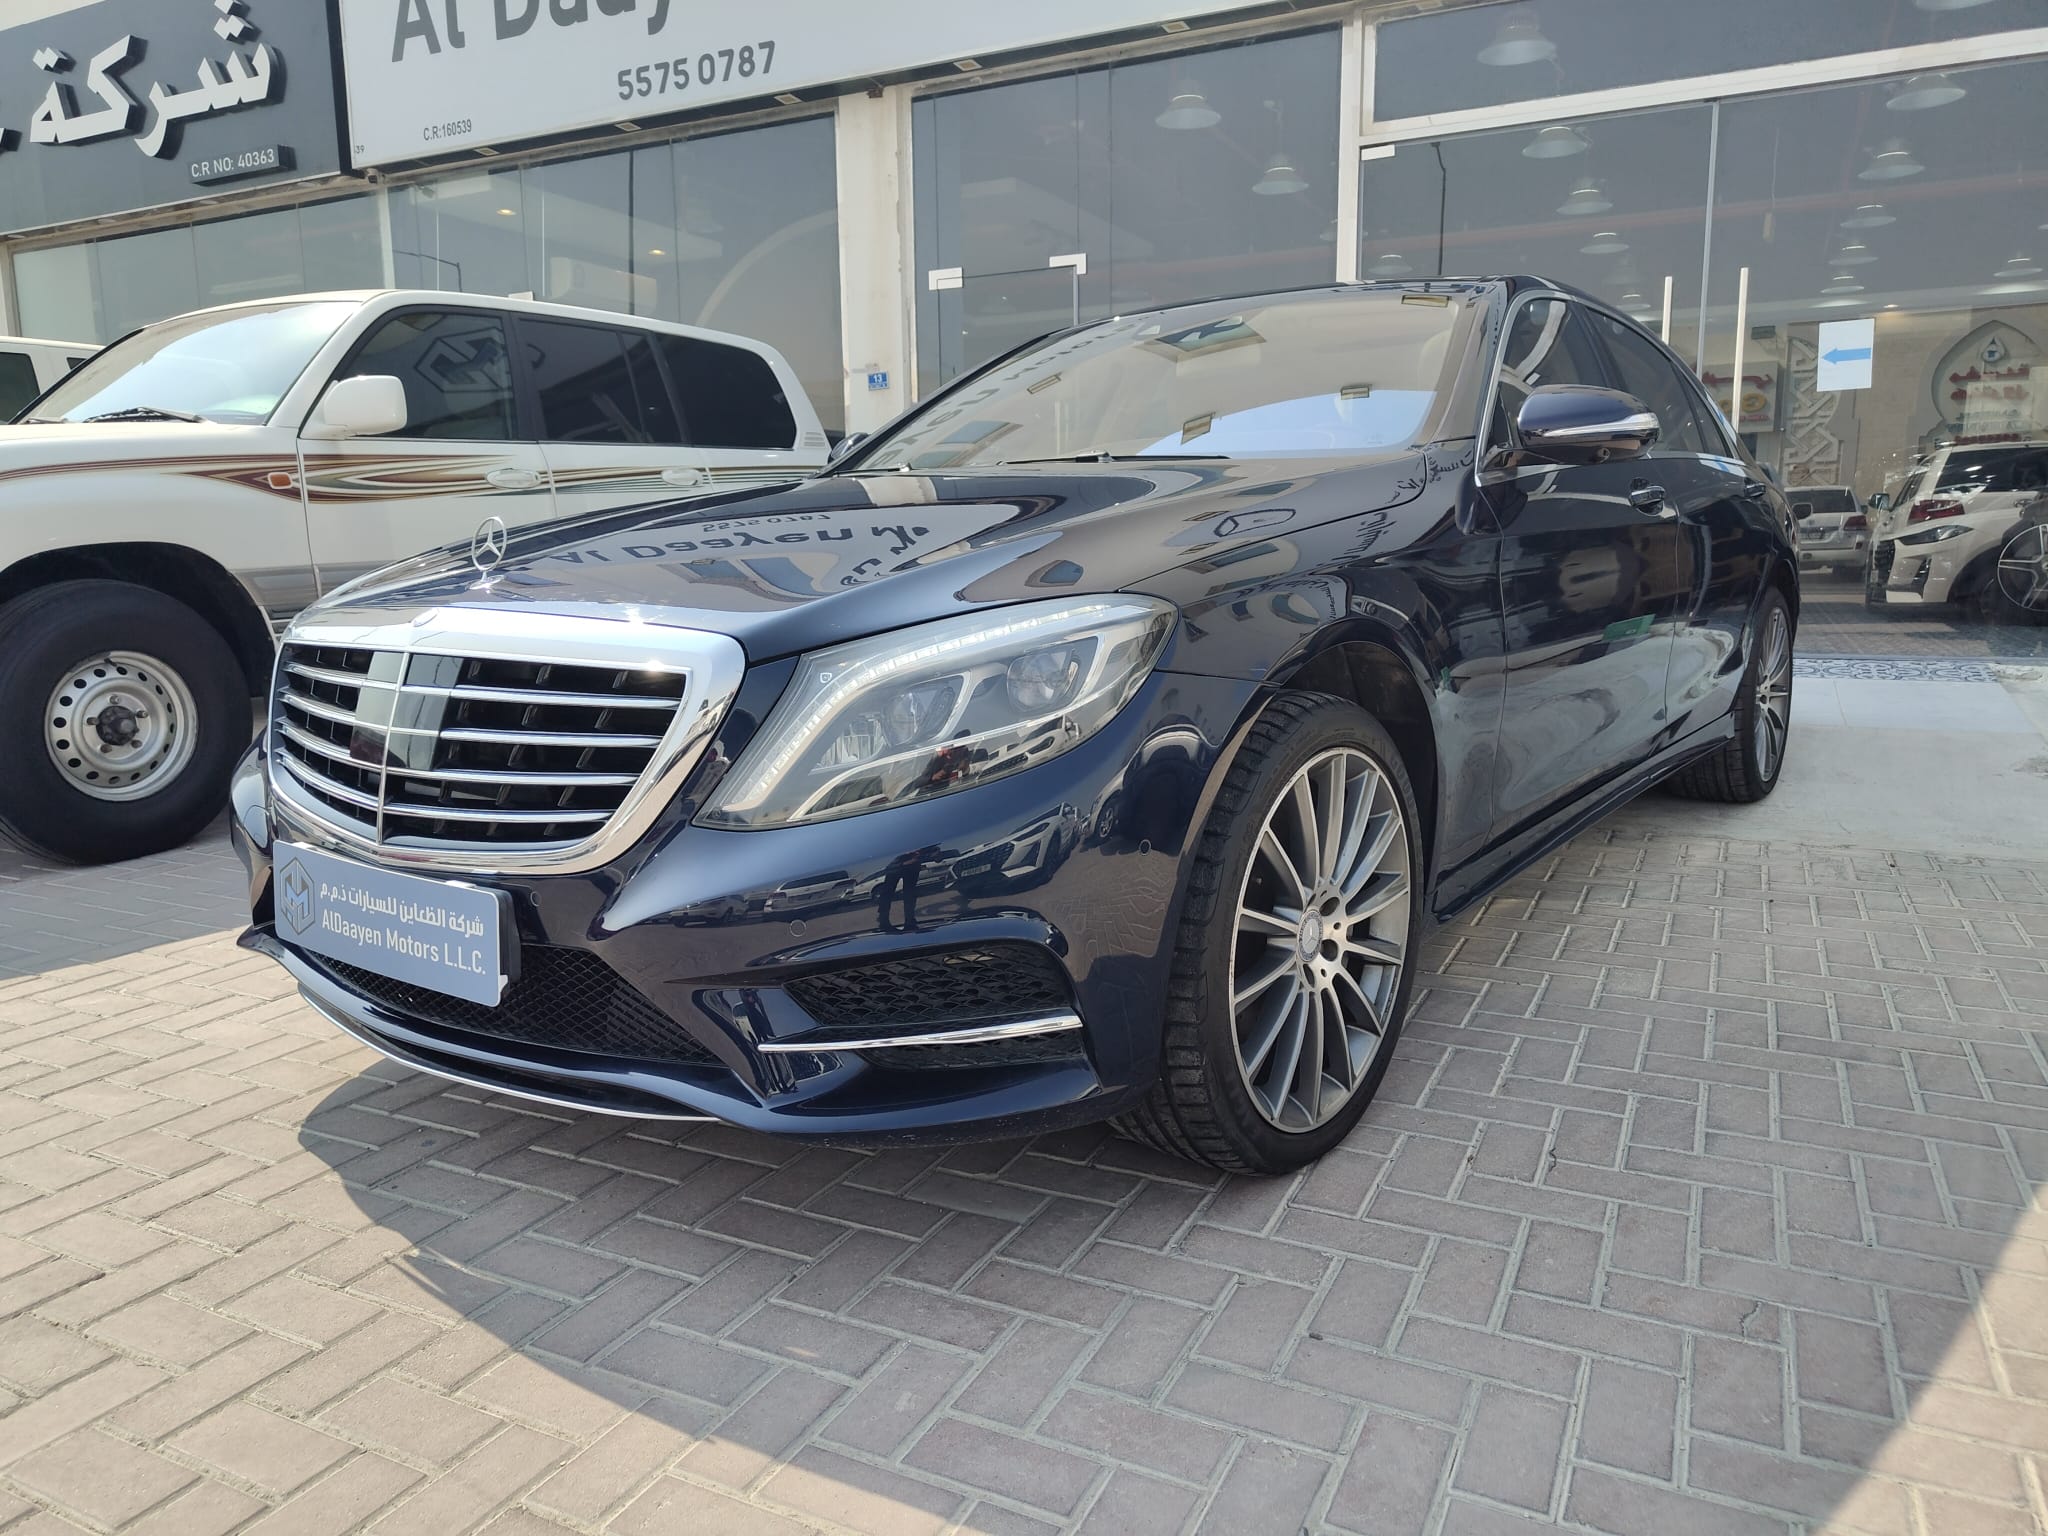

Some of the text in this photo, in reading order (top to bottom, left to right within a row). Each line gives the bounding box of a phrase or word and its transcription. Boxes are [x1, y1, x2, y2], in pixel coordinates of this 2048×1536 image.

[391, 0, 672, 62] Al Da
[30, 0, 271, 157] شركة
[617, 39, 776, 101] 5575 0787
[423, 118, 472, 141] C.R:160539
[191, 148, 275, 177] C.R NO: 40363
[349, 888, 397, 916] للسيارات
[399, 900, 446, 928] الظعاين
[449, 911, 484, 938] شركة
[322, 908, 486, 975] AlDaayen Motors L.L.C.
